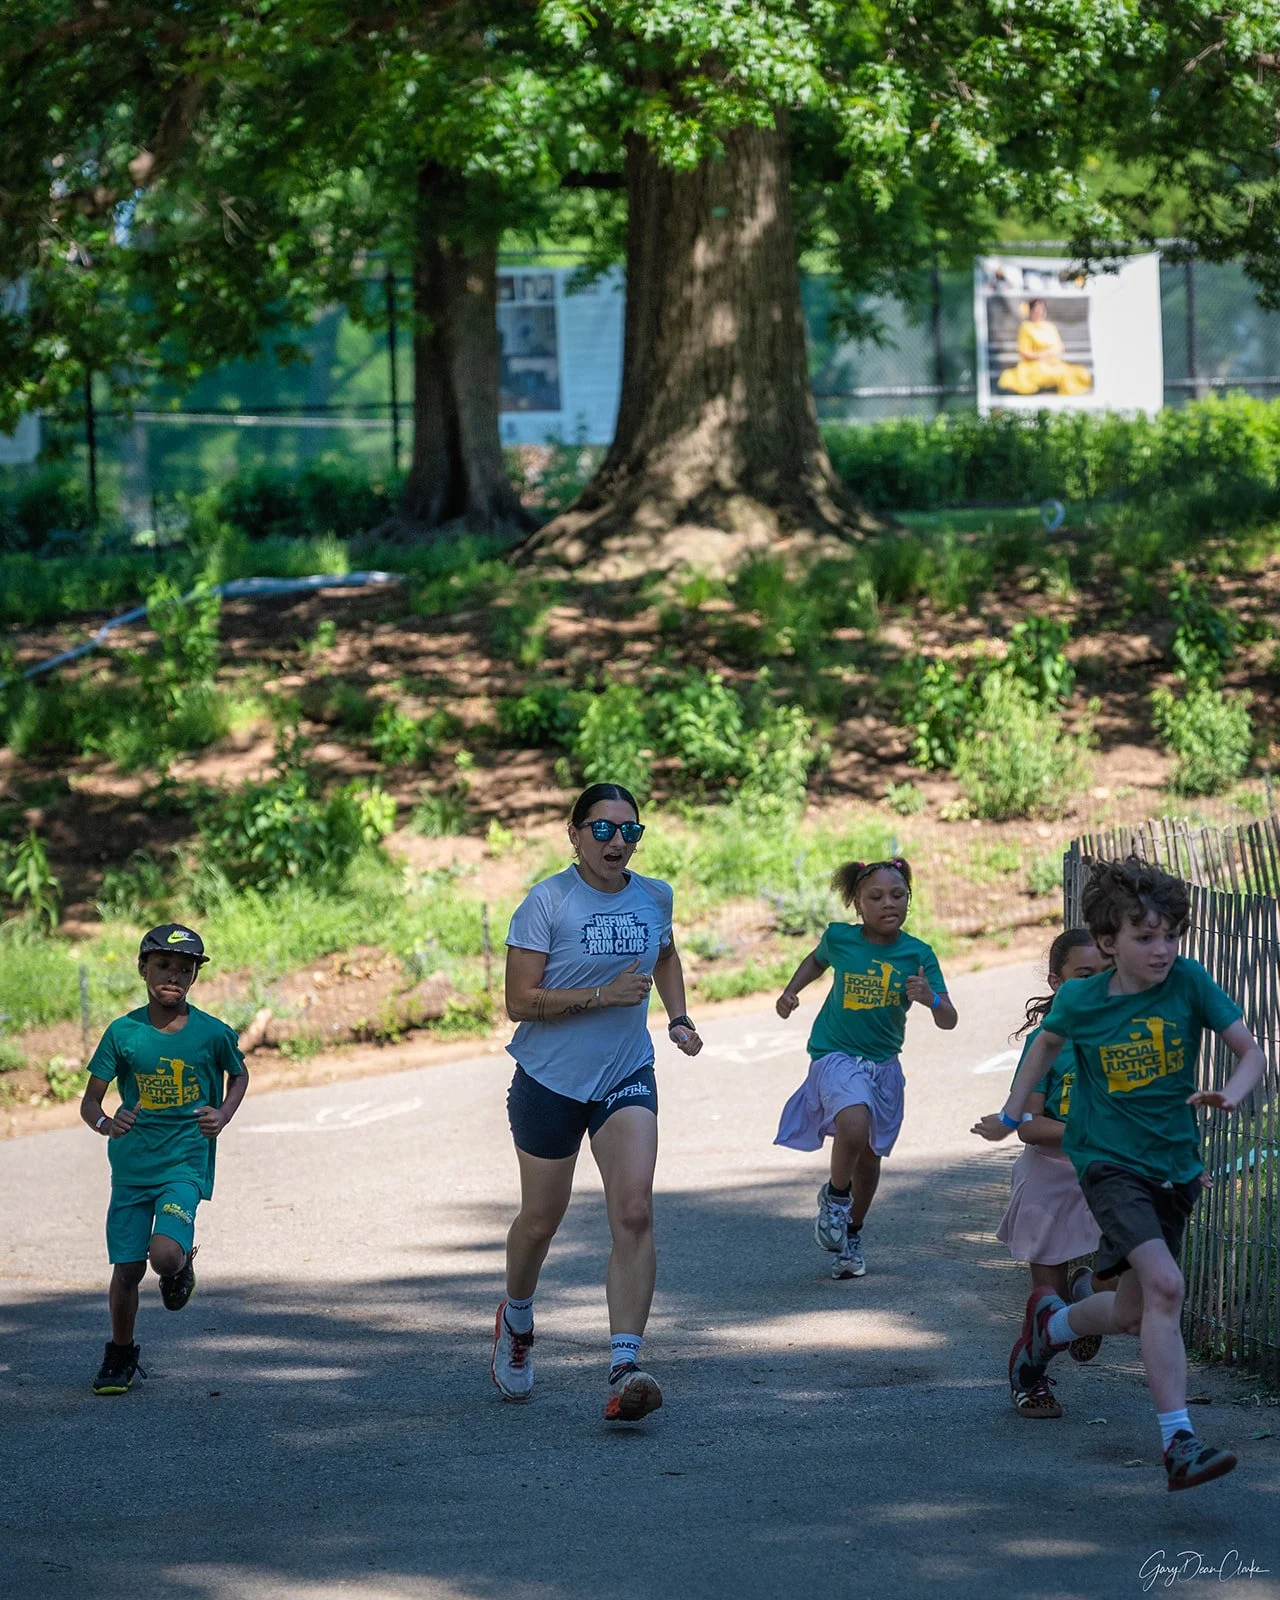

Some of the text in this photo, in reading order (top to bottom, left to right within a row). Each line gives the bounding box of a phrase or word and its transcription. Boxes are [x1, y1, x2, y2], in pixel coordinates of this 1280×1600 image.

[595, 914, 635, 927] DEFINE
[586, 926, 646, 940] NEW YORK
[589, 939, 645, 954] RUN CLUB
[847, 977, 885, 988] SOCIAL
[857, 996, 882, 1005] RUN
[1104, 1043, 1160, 1060] SOCIAL
[1106, 1053, 1162, 1074] JUSTICE
[1127, 1065, 1162, 1081] RUN
[140, 1078, 179, 1087] SOCIAL
[141, 1084, 179, 1096] JUSTICE
[184, 1084, 200, 1094] PS
[152, 1096, 180, 1104] RUN
[184, 1093, 199, 1103] 20
